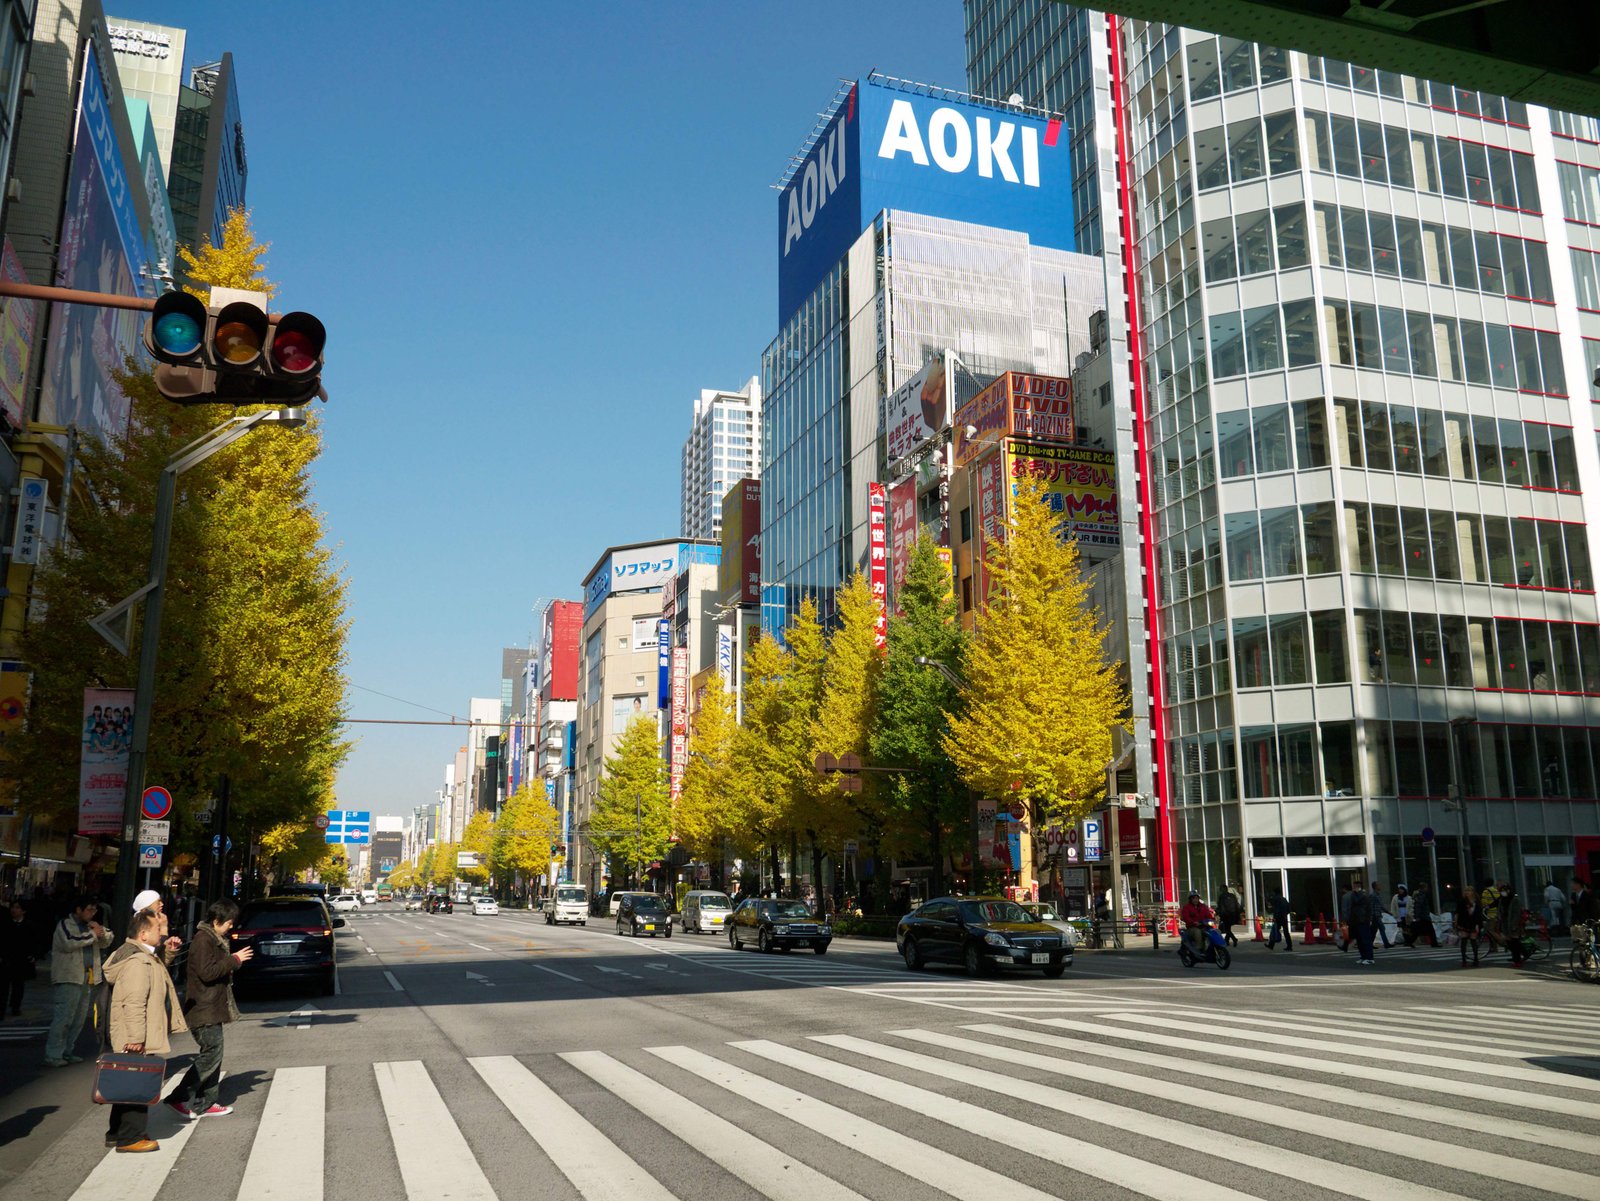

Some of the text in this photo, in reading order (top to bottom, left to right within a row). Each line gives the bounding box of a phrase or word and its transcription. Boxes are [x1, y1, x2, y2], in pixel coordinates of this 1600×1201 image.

[110, 38, 169, 59] 葉原ビル
[89, 67, 124, 207] ソフマップ
[878, 99, 1040, 188] AOKI
[784, 114, 846, 257] AOKI
[894, 379, 922, 411] ハニトー
[991, 380, 1006, 405] DVD
[1011, 375, 1069, 399] VIDEO
[901, 406, 908, 418] &
[1012, 395, 1070, 417] DVD
[1013, 411, 1071, 437] MAGAZINE
[888, 426, 922, 463] カラオケ
[1009, 443, 1026, 453] DVD
[1028, 446, 1055, 457] Blu-ray
[1057, 449, 1091, 460] TV-GAME
[1080, 534, 1090, 542] JR
[615, 558, 674, 579] ソフマップ
[720, 632, 731, 673] AKKY
[317, 818, 327, 827] 50
[1086, 823, 1099, 839] P
[1085, 847, 1095, 856] IN
